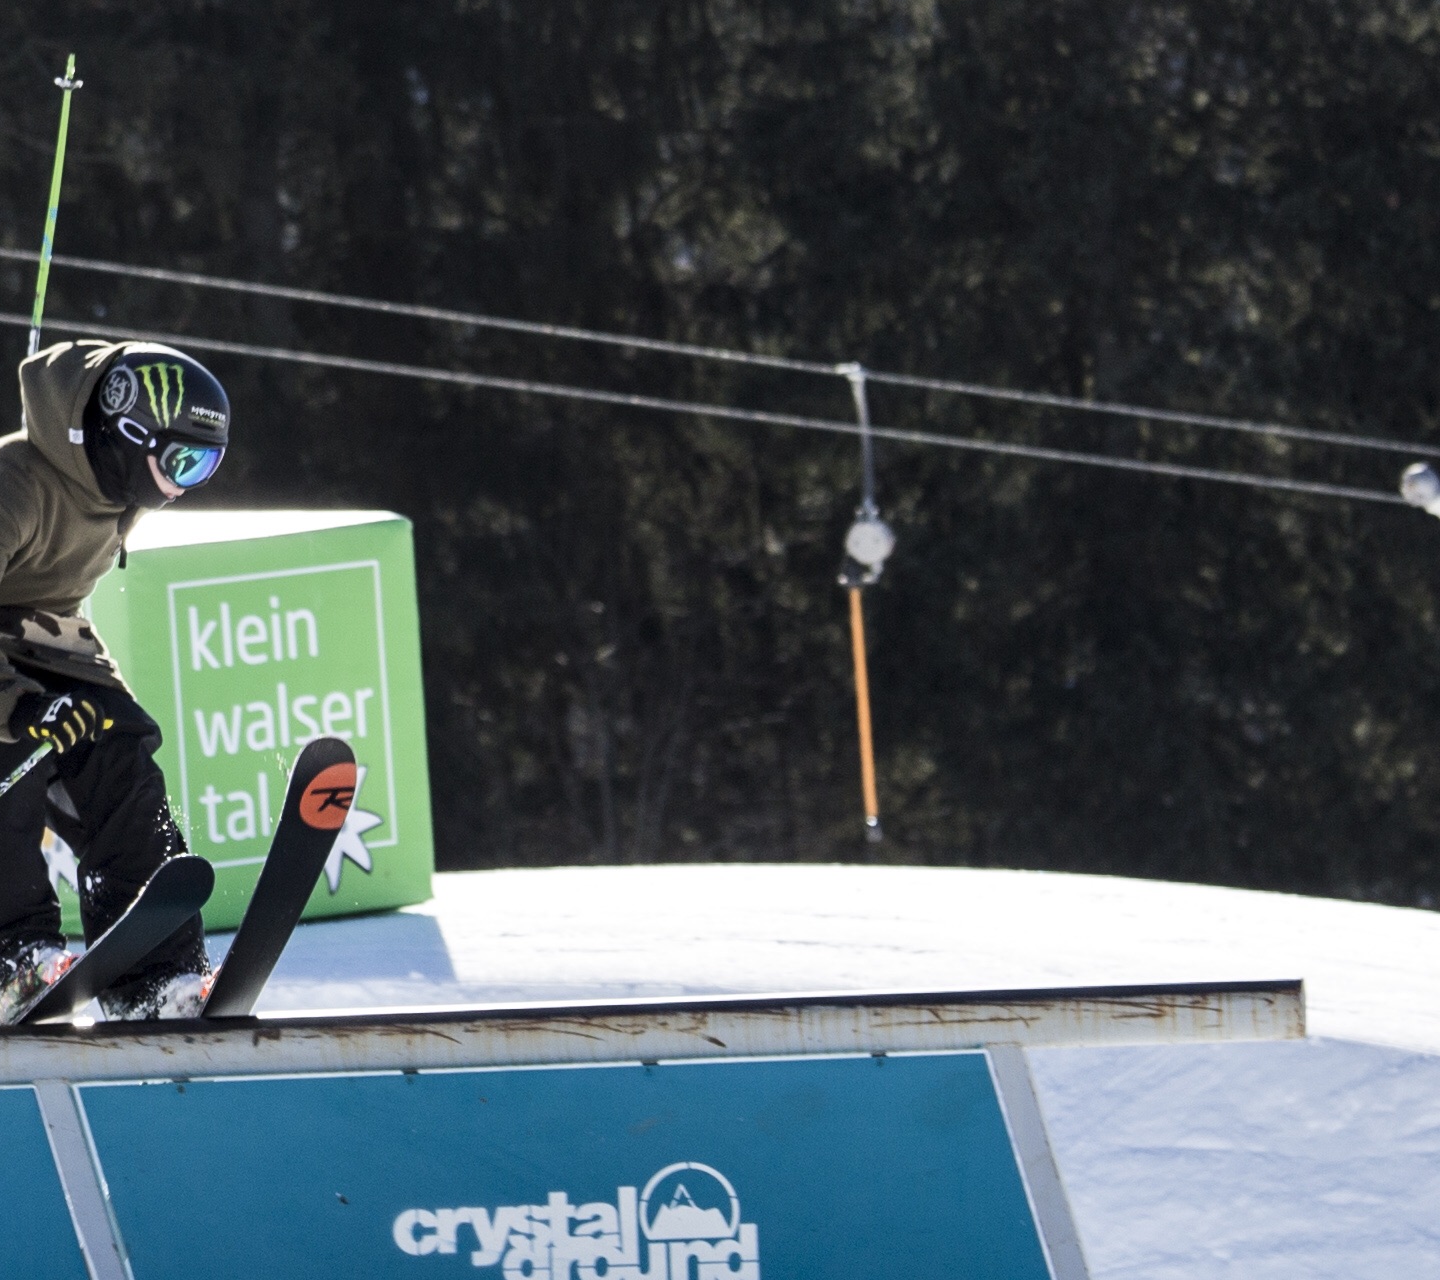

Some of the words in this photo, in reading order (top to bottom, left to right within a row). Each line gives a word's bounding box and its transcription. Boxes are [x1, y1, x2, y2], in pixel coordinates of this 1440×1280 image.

[188, 596, 319, 670] klein
[194, 682, 373, 758] walser
[199, 772, 270, 843] tal
[393, 1185, 638, 1267] crystal
